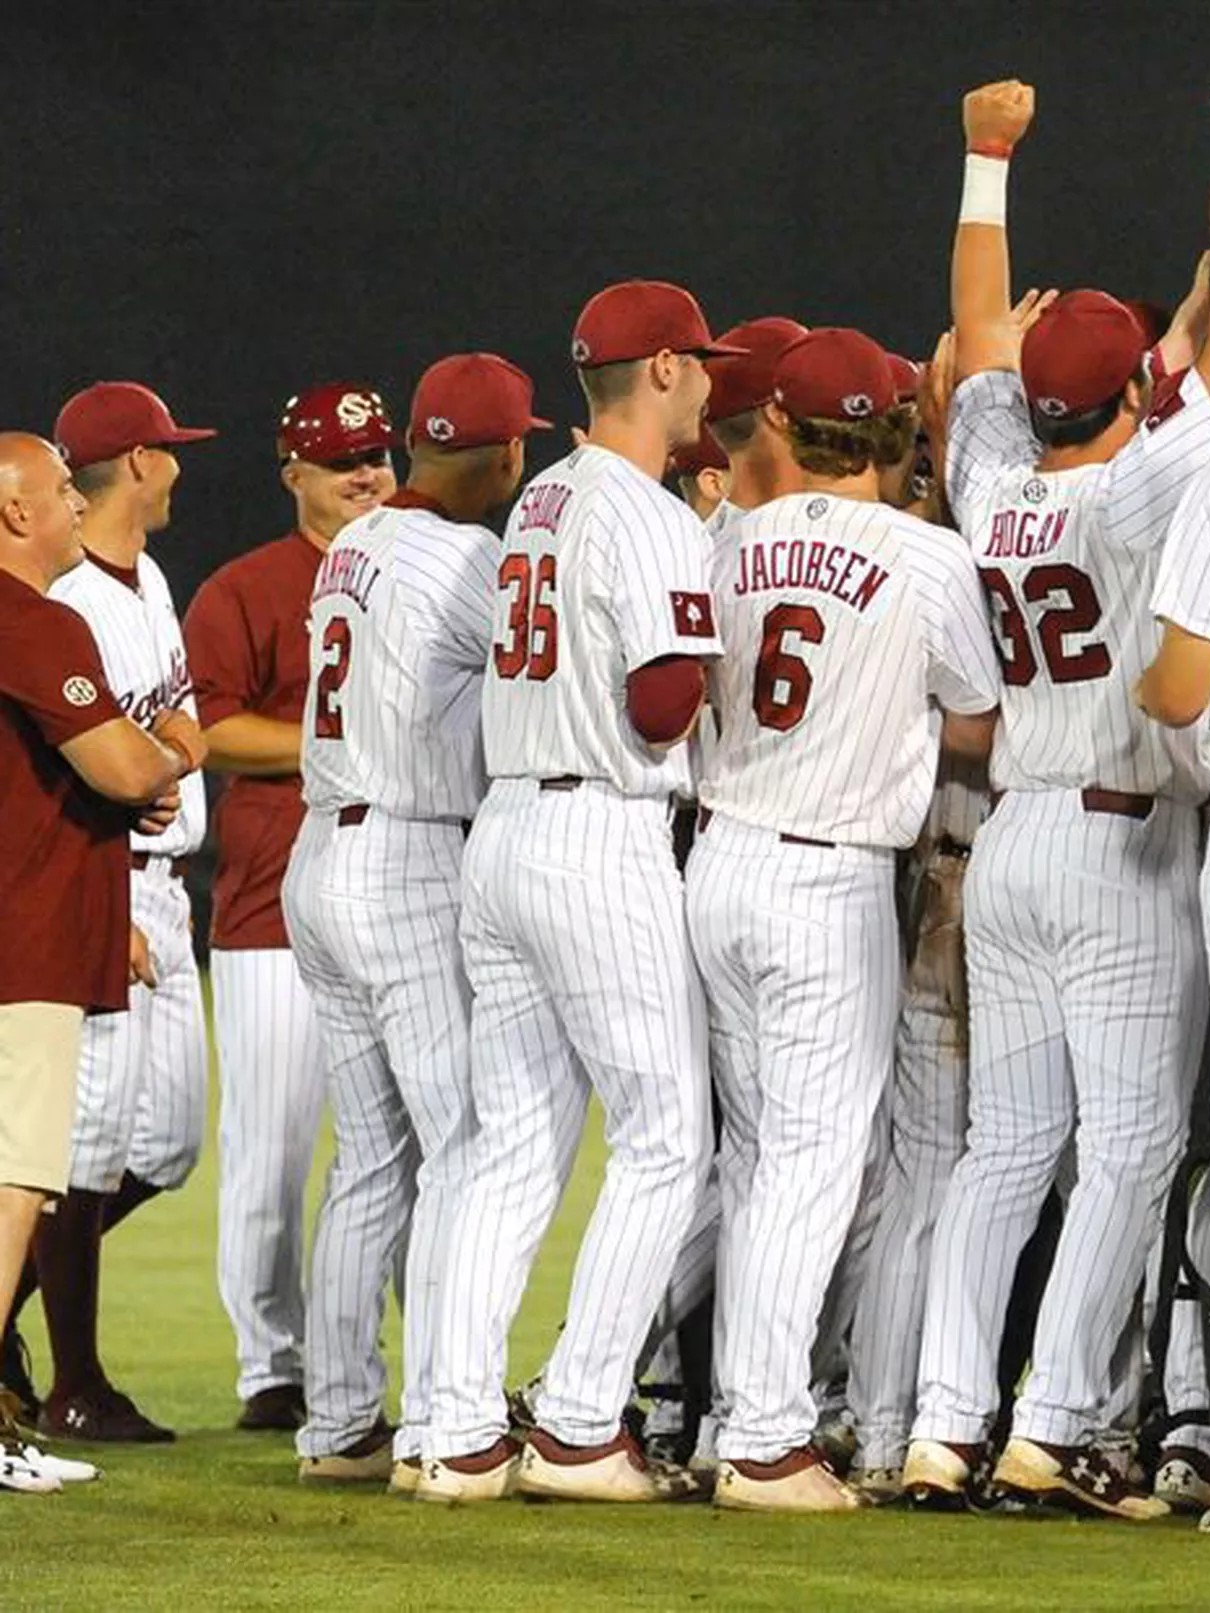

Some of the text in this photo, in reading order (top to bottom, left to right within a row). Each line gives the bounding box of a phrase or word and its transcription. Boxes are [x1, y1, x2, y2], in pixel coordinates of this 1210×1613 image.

[734, 540, 889, 613] JACOBSEN
[984, 508, 1069, 558] HOGAN
[315, 616, 352, 739] 2
[494, 552, 558, 682] 36
[753, 602, 826, 732] 6
[979, 562, 1112, 687] 32
